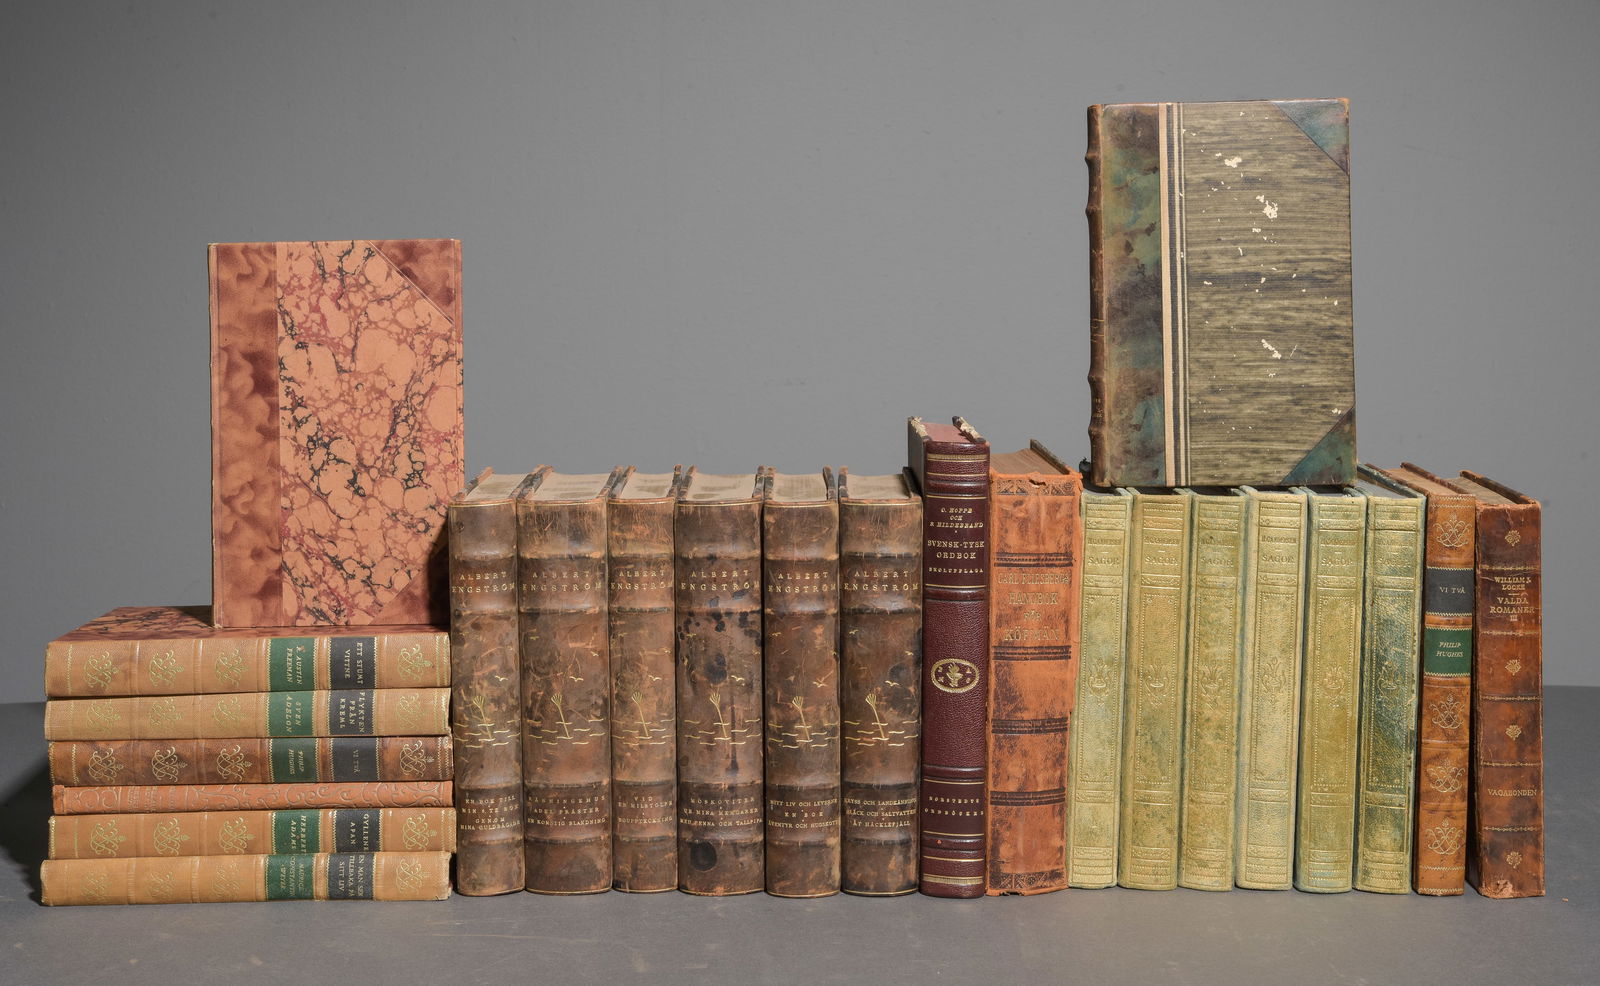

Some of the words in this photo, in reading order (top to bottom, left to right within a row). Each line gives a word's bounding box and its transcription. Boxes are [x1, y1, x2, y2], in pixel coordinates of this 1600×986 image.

[936, 521, 984, 529] HILDEBRAND
[927, 540, 985, 549] SVENSK-TYSK
[1087, 556, 1120, 566] SAGOR
[1261, 555, 1295, 564] SAGOR
[460, 571, 507, 580] ALBERT
[533, 571, 590, 579] ALBERT
[691, 570, 749, 578] ALBERT
[778, 572, 829, 580] ALBERT
[1494, 576, 1525, 584] WILLIAM
[1452, 586, 1465, 594] TVÅ
[1009, 592, 1058, 605] HANDBOK
[1497, 597, 1529, 605] VALDA
[1489, 606, 1535, 614] ROMANER
[1487, 788, 1537, 797] VAGABONDEN
[358, 855, 365, 864] EN
[357, 867, 365, 883] MAN
